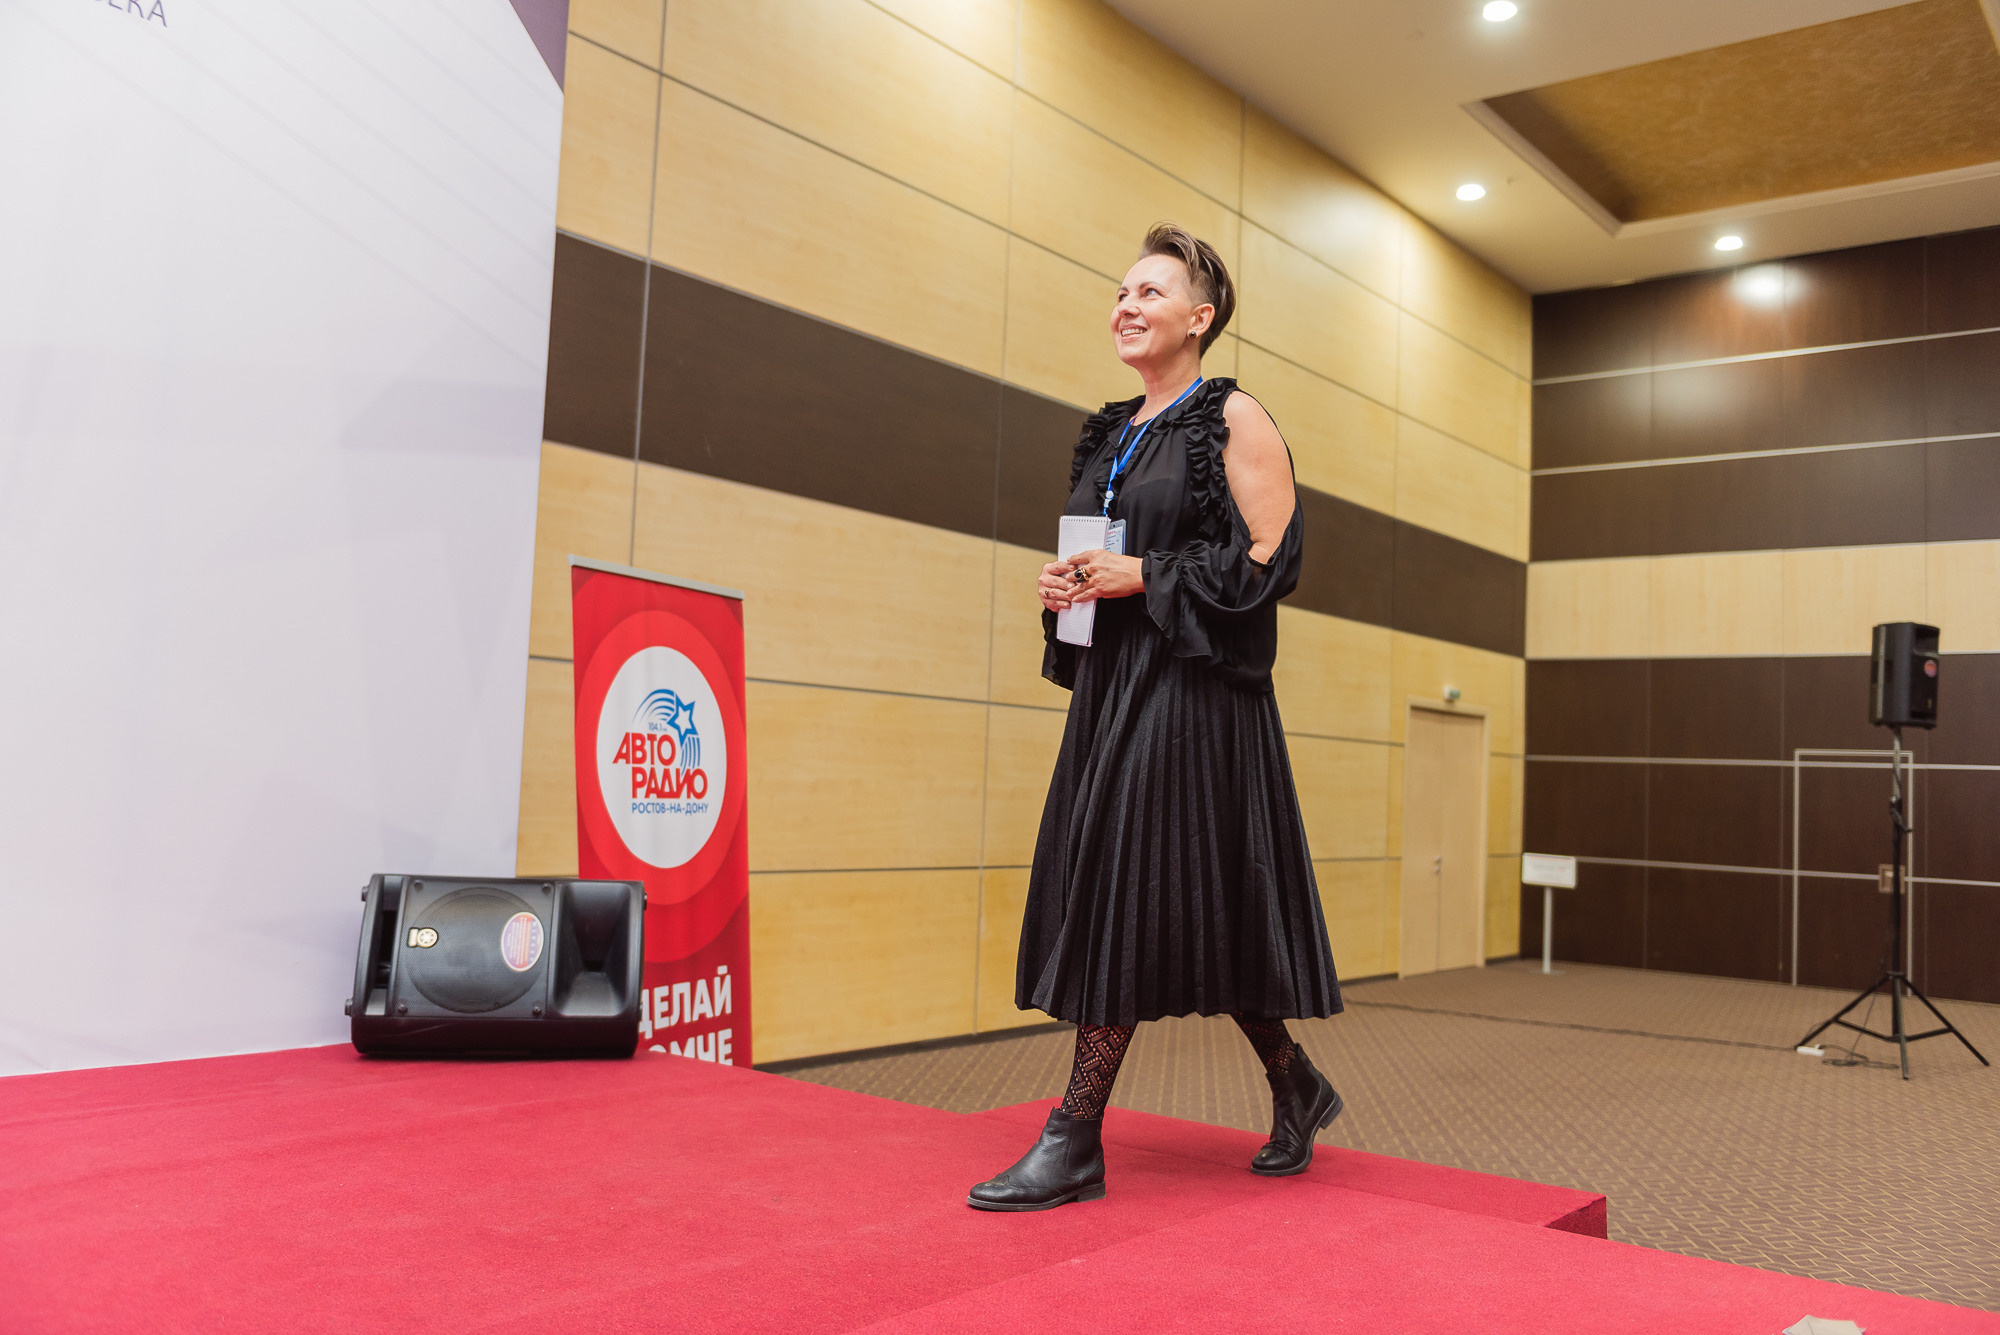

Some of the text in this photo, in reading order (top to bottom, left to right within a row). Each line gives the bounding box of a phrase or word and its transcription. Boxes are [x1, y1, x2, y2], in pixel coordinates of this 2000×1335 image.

[612, 732, 676, 766] АВТО
[631, 766, 708, 799] РАДИО
[631, 802, 709, 815] РОСТОВ-НА-ДОНУ
[649, 1028, 733, 1067] ЧЕ
